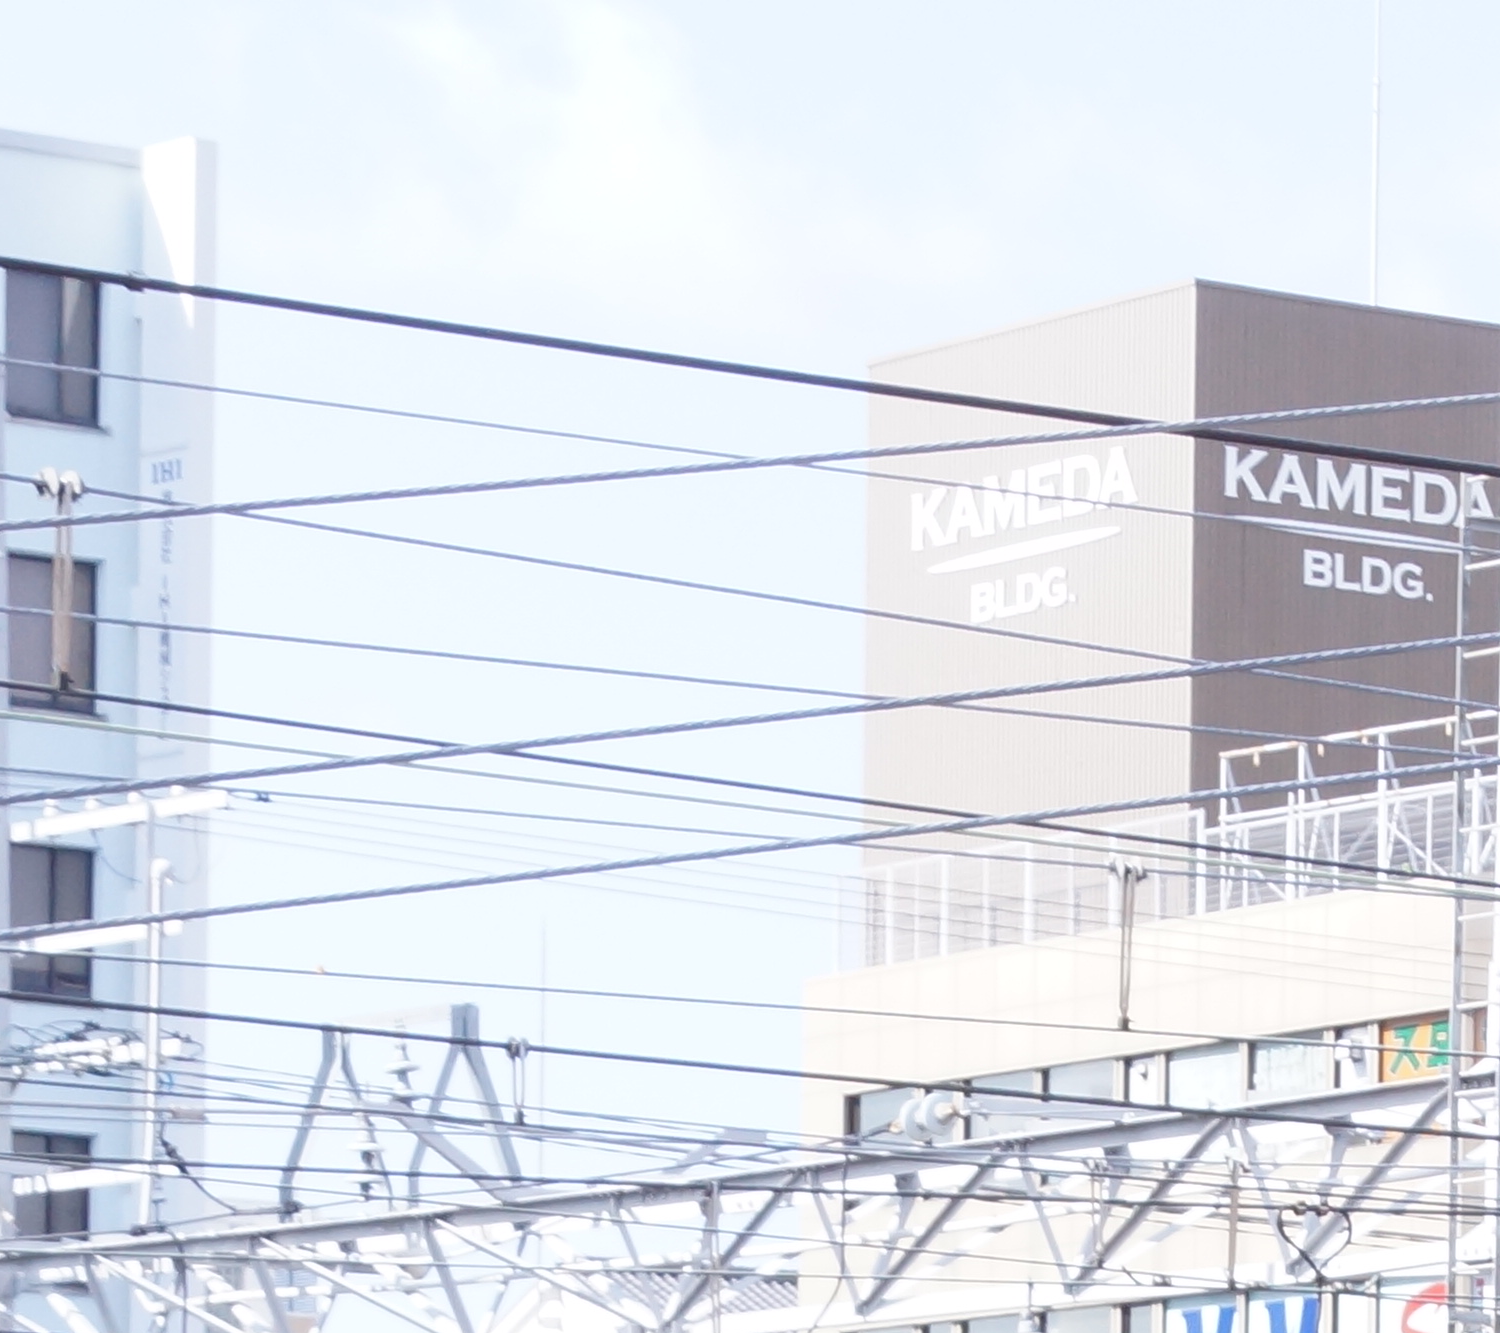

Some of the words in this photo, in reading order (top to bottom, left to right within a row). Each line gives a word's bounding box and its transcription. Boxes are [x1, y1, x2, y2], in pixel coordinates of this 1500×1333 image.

[909, 444, 1140, 552] KAMEDA
[1222, 443, 1500, 526] KAMEDA
[969, 565, 1077, 626] BLDG.
[1302, 548, 1435, 604] BLDG.
